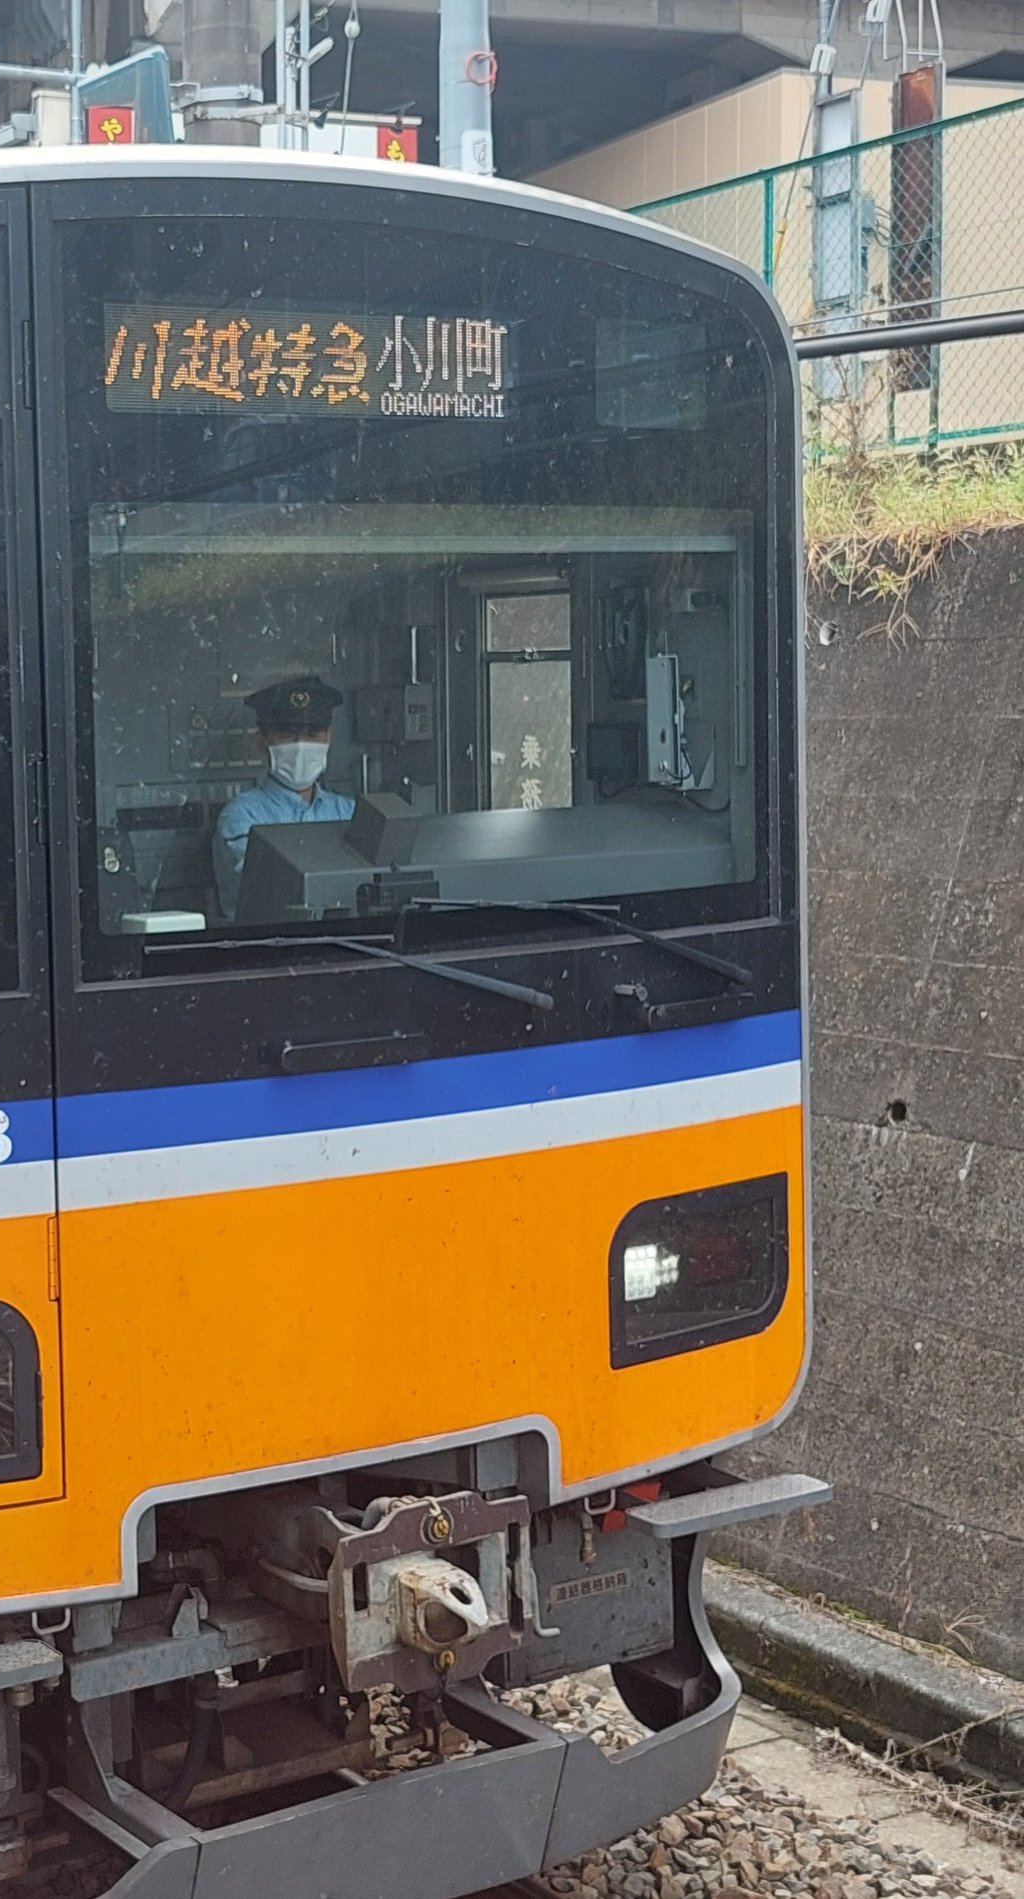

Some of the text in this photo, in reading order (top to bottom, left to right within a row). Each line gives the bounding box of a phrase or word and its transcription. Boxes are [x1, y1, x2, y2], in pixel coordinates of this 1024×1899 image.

[105, 315, 507, 404] 川越特急 小川町
[381, 391, 505, 418] OGAWAMACHI
